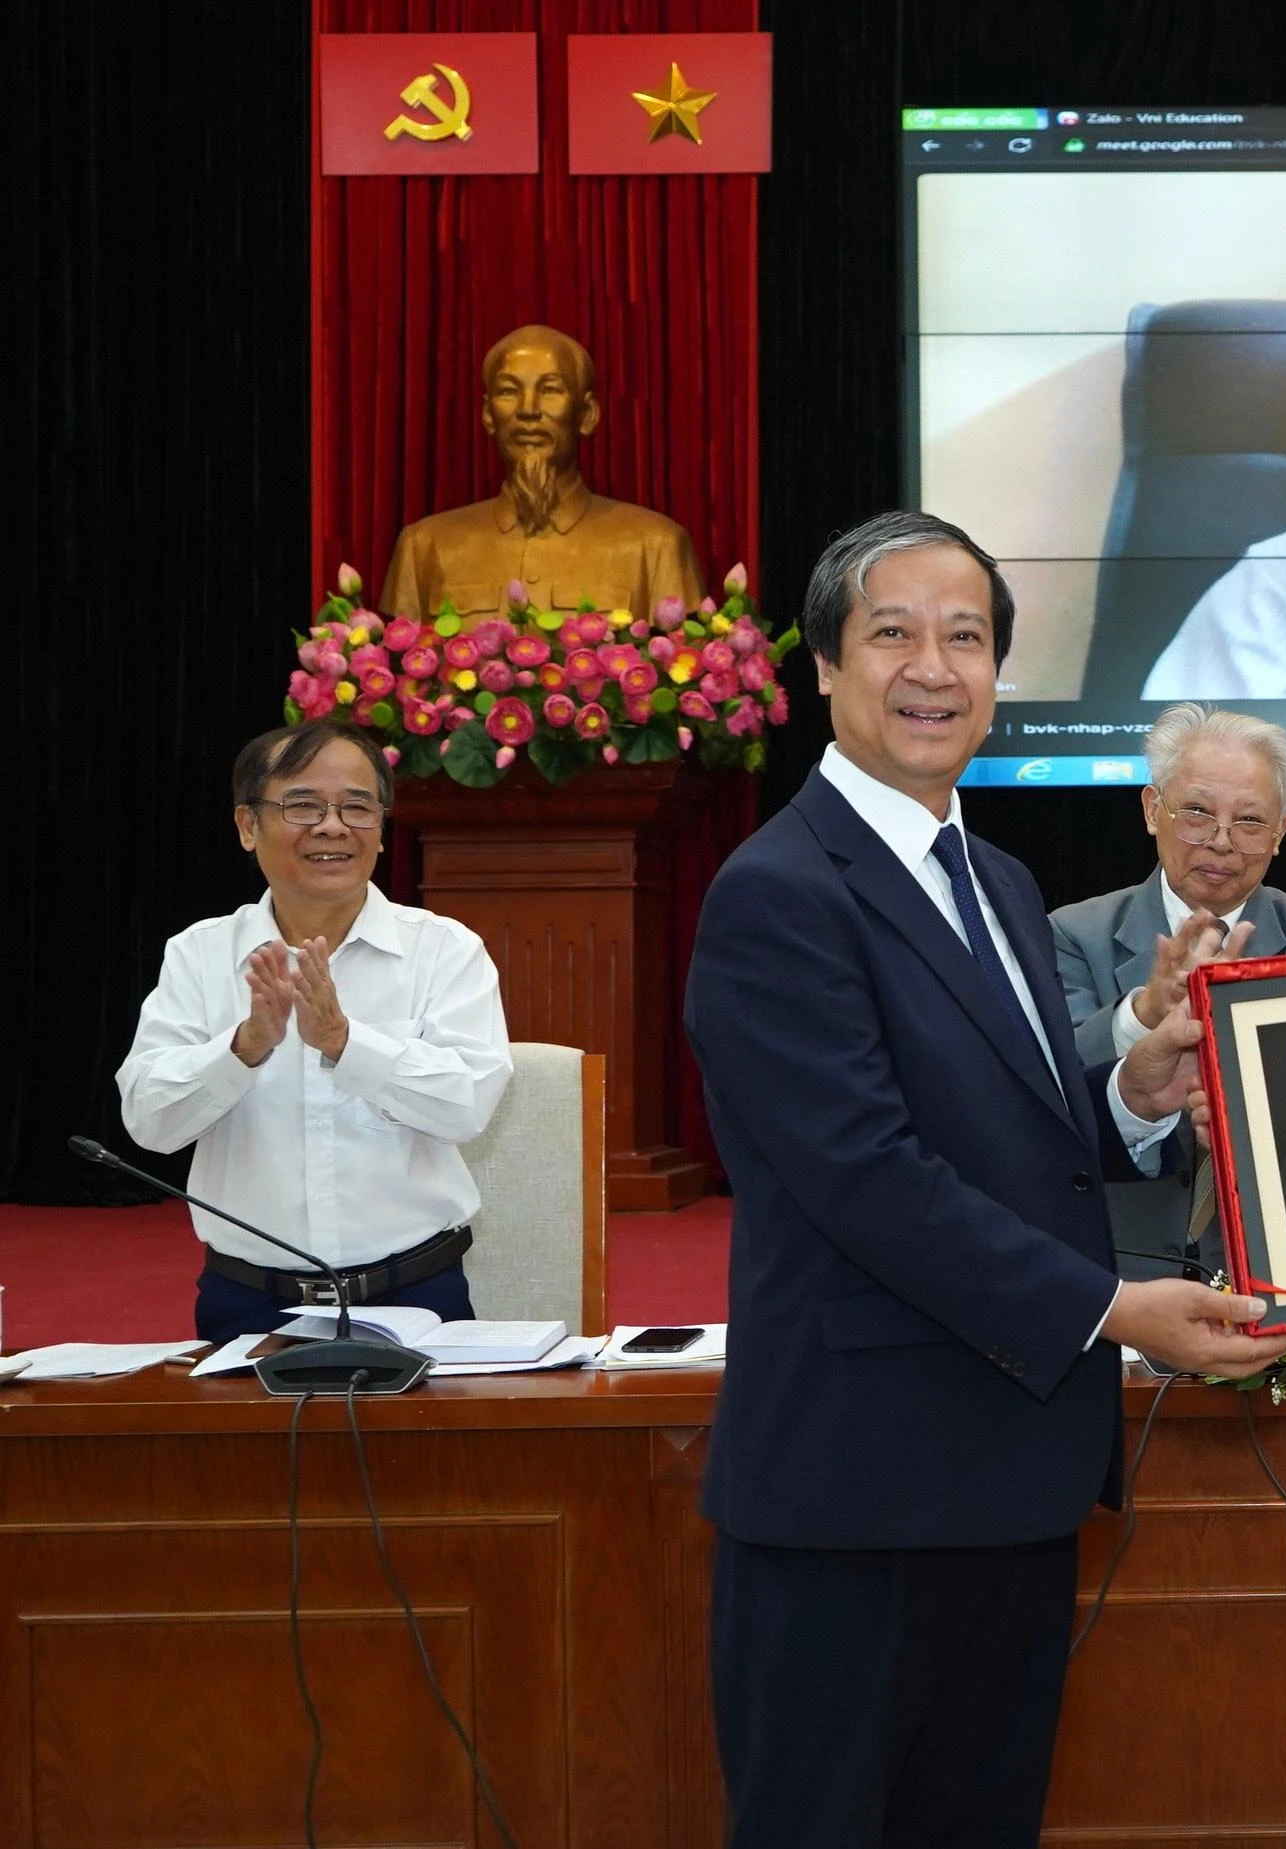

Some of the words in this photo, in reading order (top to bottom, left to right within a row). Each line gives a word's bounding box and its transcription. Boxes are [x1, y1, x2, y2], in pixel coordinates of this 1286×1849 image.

[1086, 113, 1122, 124] Zalo
[1136, 113, 1162, 124] Vni
[1165, 113, 1244, 124] Education
[1023, 723, 1154, 735] bvk-nhap-vzc
